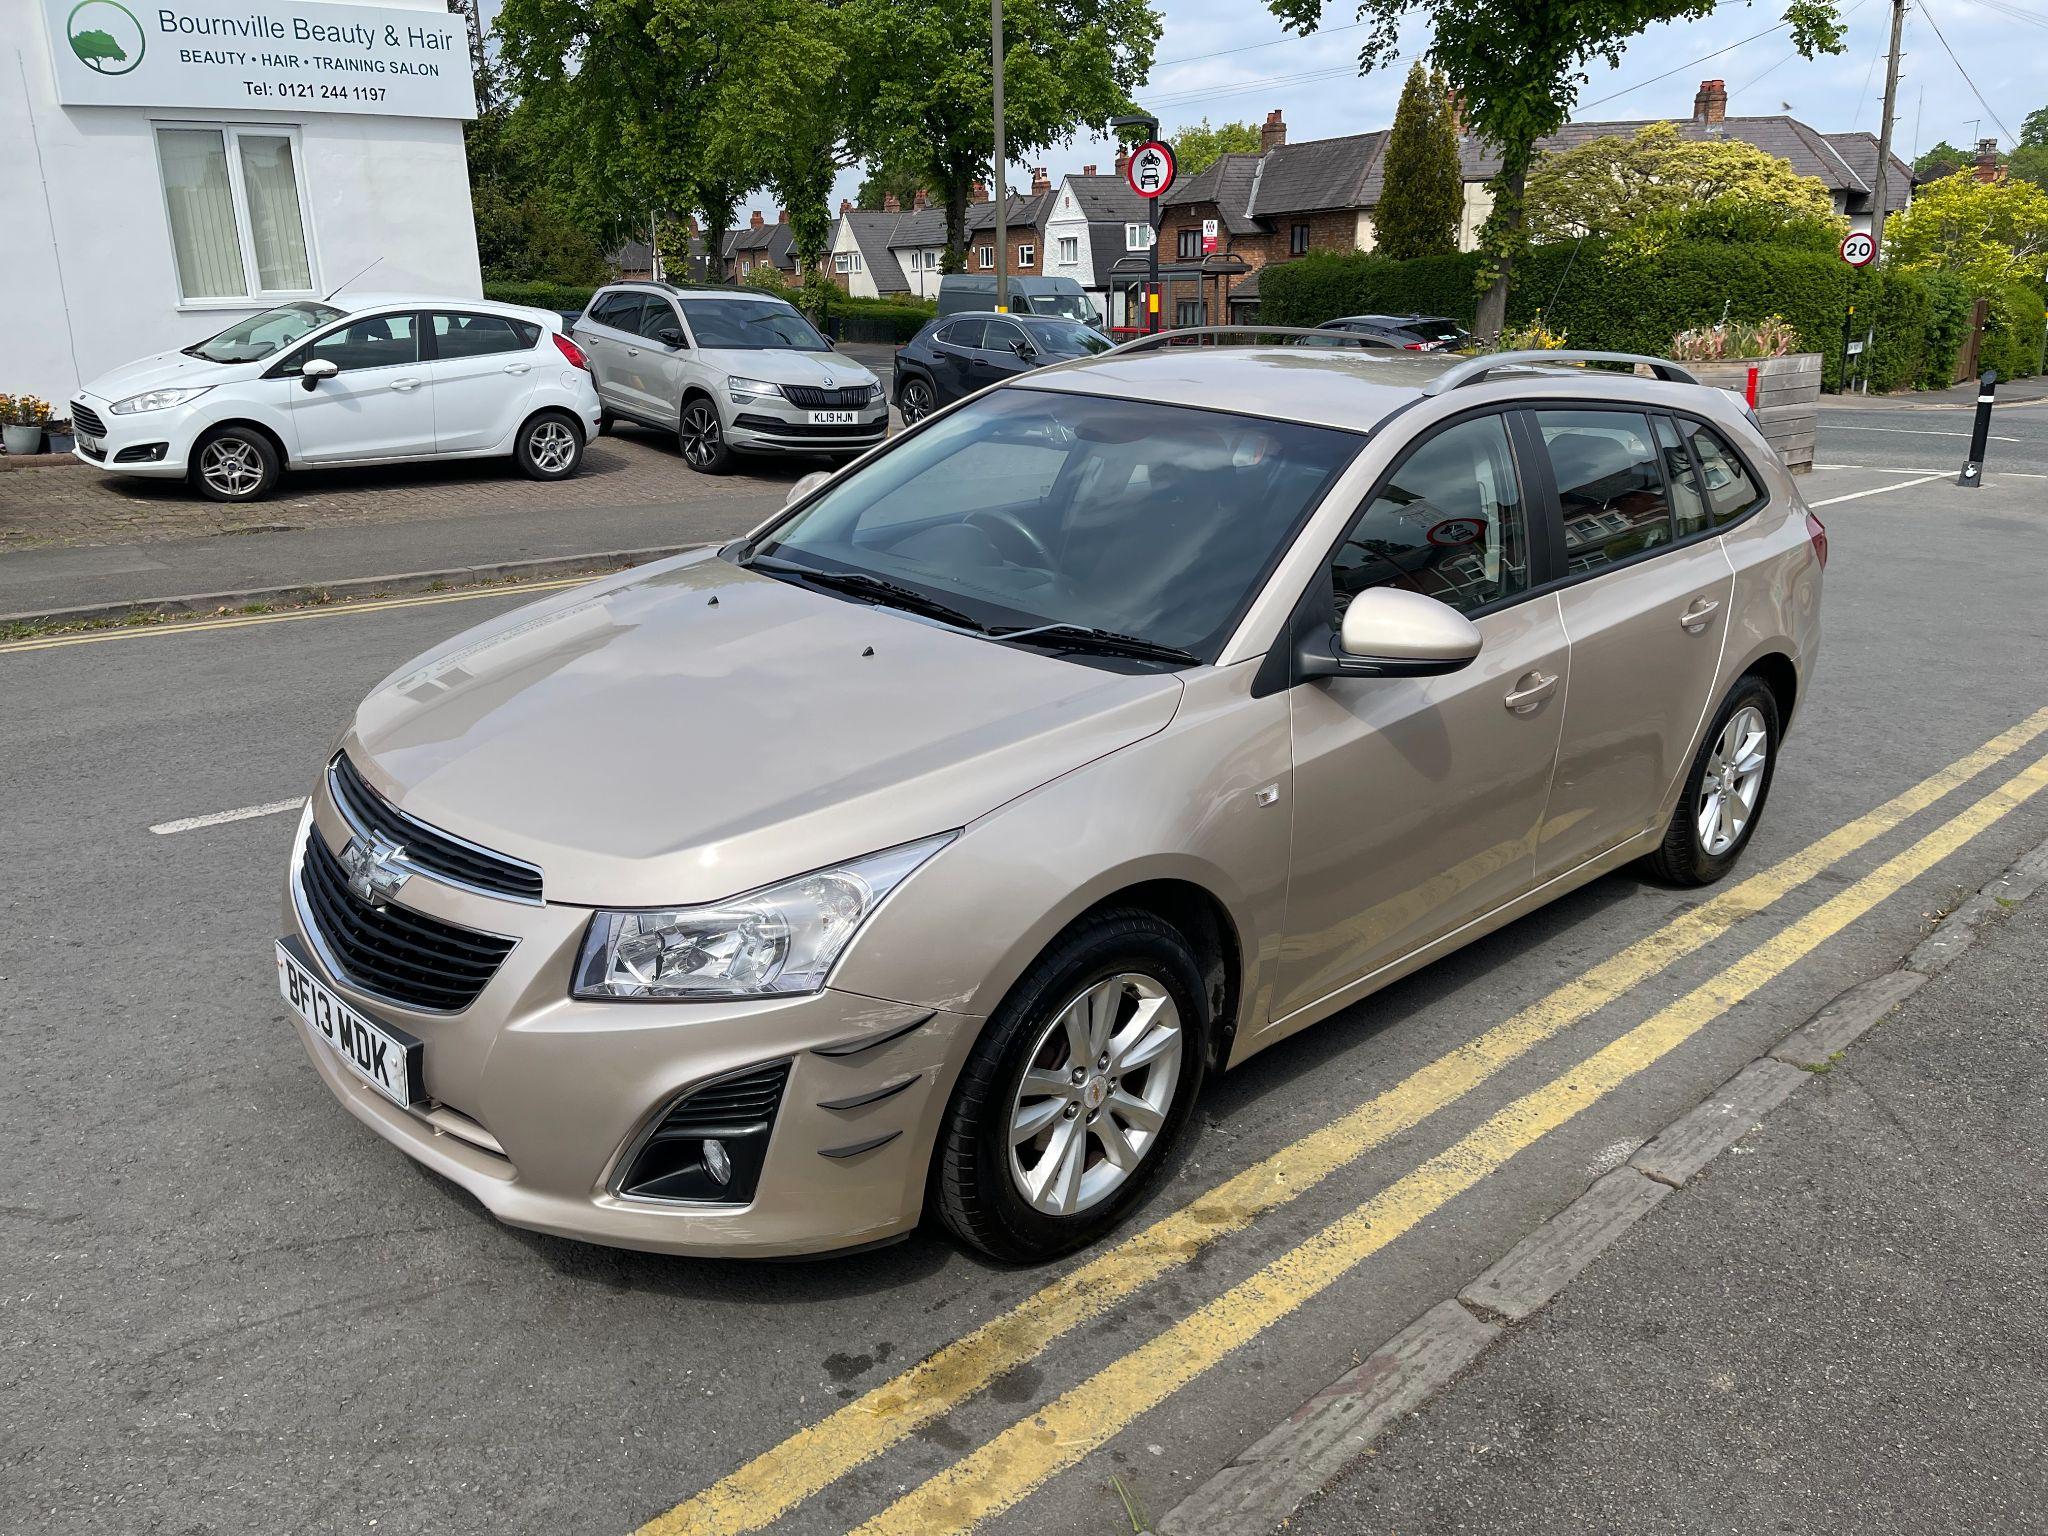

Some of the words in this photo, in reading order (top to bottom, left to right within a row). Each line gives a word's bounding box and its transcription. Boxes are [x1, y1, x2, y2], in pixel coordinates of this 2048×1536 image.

[158, 9, 285, 39] Bournville
[292, 17, 375, 51] Beauty
[384, 24, 401, 47] &
[407, 26, 453, 51] Hair
[179, 49, 247, 65] BEAUTY
[261, 53, 300, 68] HAIR
[313, 56, 385, 73] TRAINING
[389, 61, 439, 77] SALON
[243, 81, 273, 96] Tel:
[278, 82, 314, 98] 0121
[320, 85, 348, 99] 244
[353, 87, 386, 101] 1197
[1846, 242, 1871, 256] 20
[814, 412, 835, 423] KL19
[836, 412, 853, 423] HJN
[285, 957, 334, 1039] BF13
[336, 1005, 391, 1088] MDK
